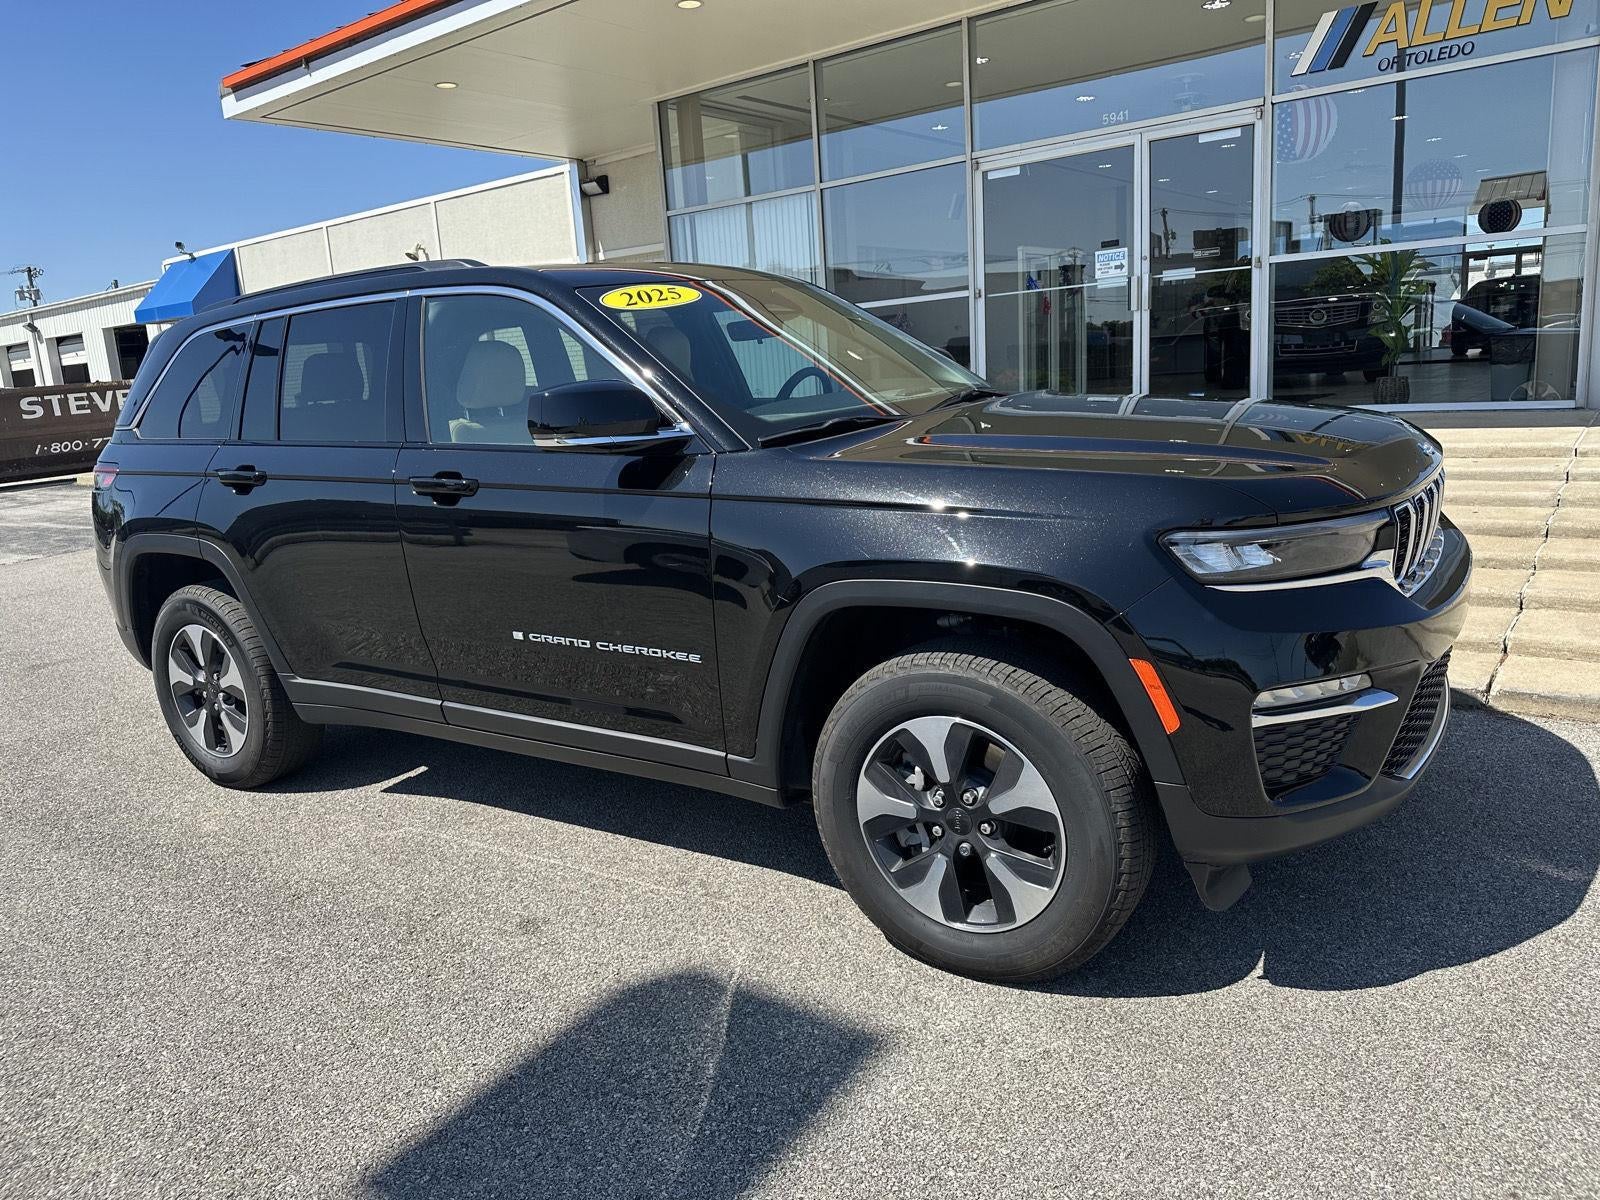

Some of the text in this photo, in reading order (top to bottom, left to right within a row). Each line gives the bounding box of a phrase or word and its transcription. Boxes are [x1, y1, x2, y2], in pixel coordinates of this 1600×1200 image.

[1405, 41, 1475, 67] TOLEDO
[1102, 109, 1129, 125] 5941
[1098, 251, 1125, 262] NOTICE
[619, 287, 682, 307] 2025
[528, 633, 702, 664] GRAND CHEROKEE
